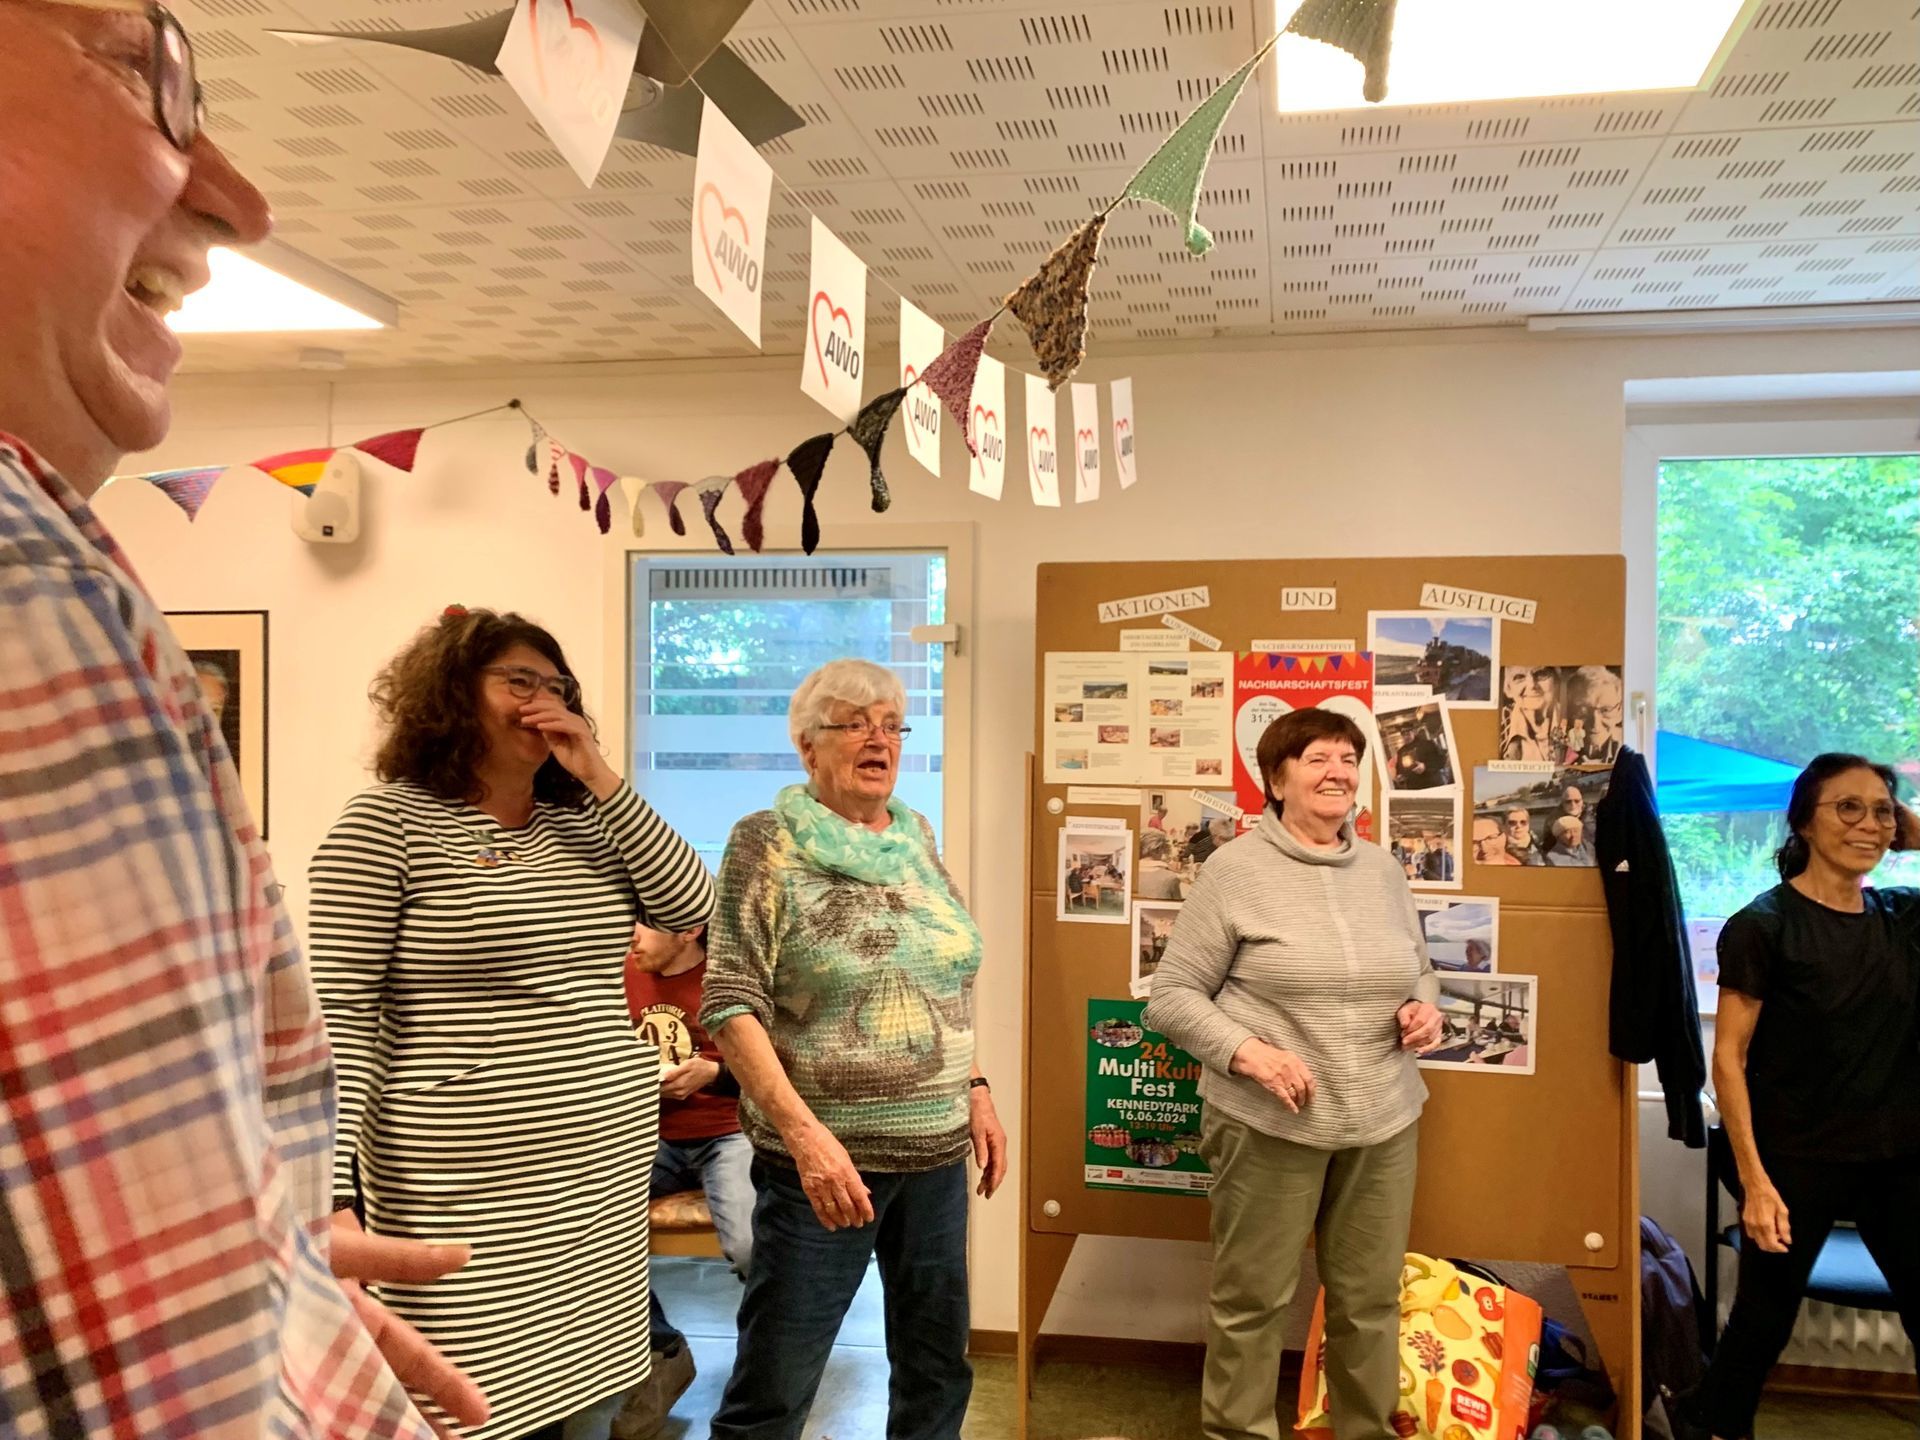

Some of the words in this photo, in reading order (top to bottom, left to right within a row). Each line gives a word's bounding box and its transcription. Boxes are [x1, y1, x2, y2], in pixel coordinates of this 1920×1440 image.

[714, 230, 759, 293] AWO
[825, 331, 860, 381] AWO
[914, 397, 938, 436] AWO
[981, 432, 1003, 463] AWO
[1039, 449, 1055, 474] AWO
[1084, 449, 1098, 470] AWO
[1102, 589, 1207, 620] AKTIONEN
[1285, 591, 1333, 607] UND
[1239, 680, 1369, 690] NACHBARSCHAFTSFEST
[1131, 1078, 1176, 1097] Fest
[1107, 1098, 1199, 1114] KENNEDYPARK
[1119, 1109, 1187, 1124] 16.06.2024
[1457, 1394, 1487, 1414] REWE
